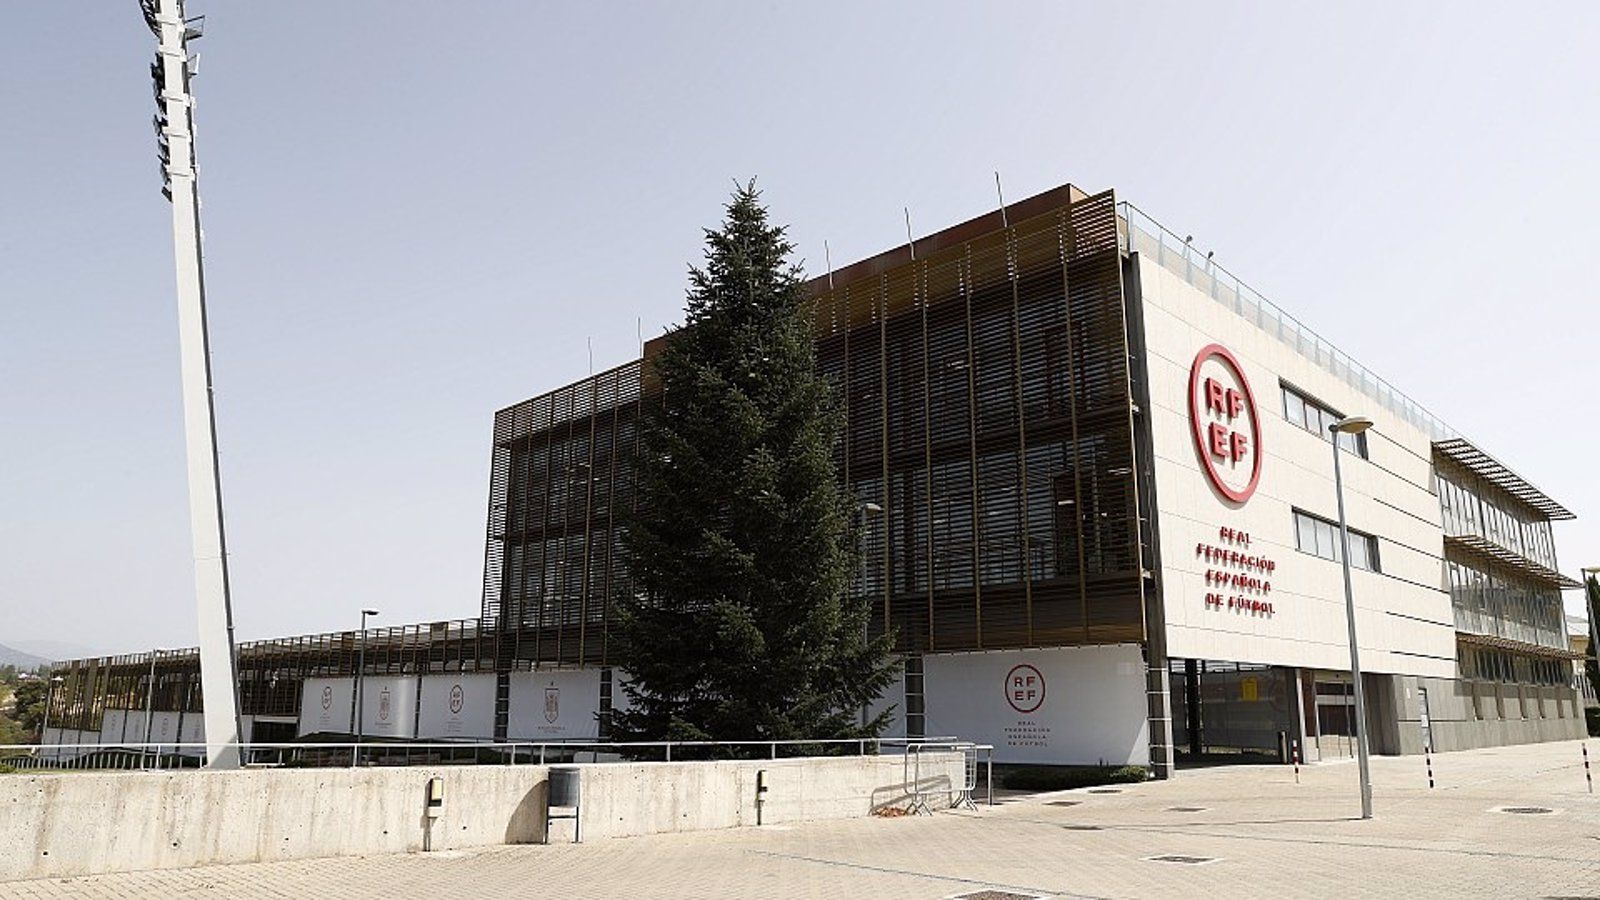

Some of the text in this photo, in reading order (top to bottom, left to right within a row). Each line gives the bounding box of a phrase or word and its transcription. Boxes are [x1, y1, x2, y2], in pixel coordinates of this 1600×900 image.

[1205, 377, 1244, 419] RF
[1208, 421, 1248, 463] EF
[1219, 526, 1252, 544] REAL
[1196, 543, 1276, 571] FEDERACIÓN
[1205, 569, 1271, 592] ESPAÑOLA
[1205, 593, 1276, 614] DE FÚTBOL
[1014, 676, 1036, 687] RF
[1014, 690, 1036, 701] EF
